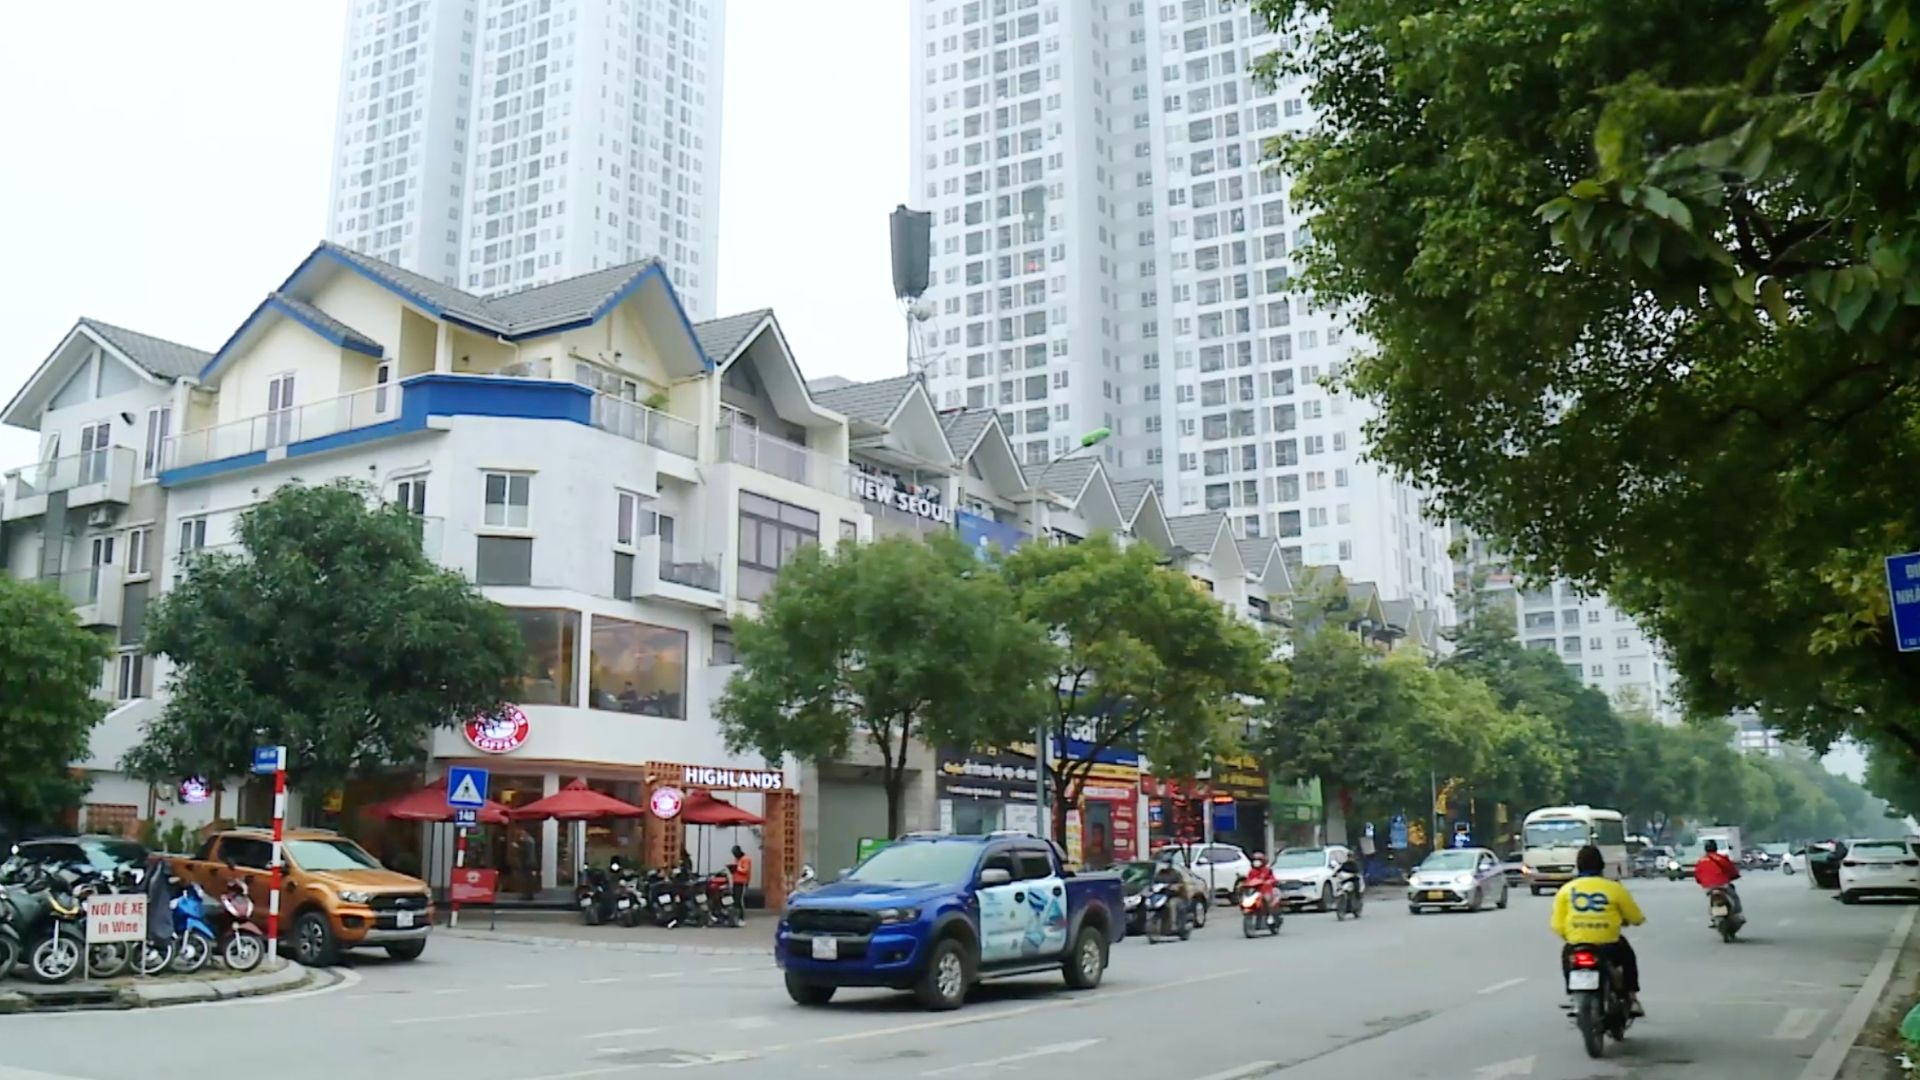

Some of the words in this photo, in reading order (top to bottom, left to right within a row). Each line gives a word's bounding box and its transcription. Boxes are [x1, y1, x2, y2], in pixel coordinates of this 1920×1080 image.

[851, 476, 892, 504] NEW
[897, 493, 952, 523] SEOUL
[685, 766, 782, 789] HIGHLANDS
[1571, 887, 1609, 912] be
